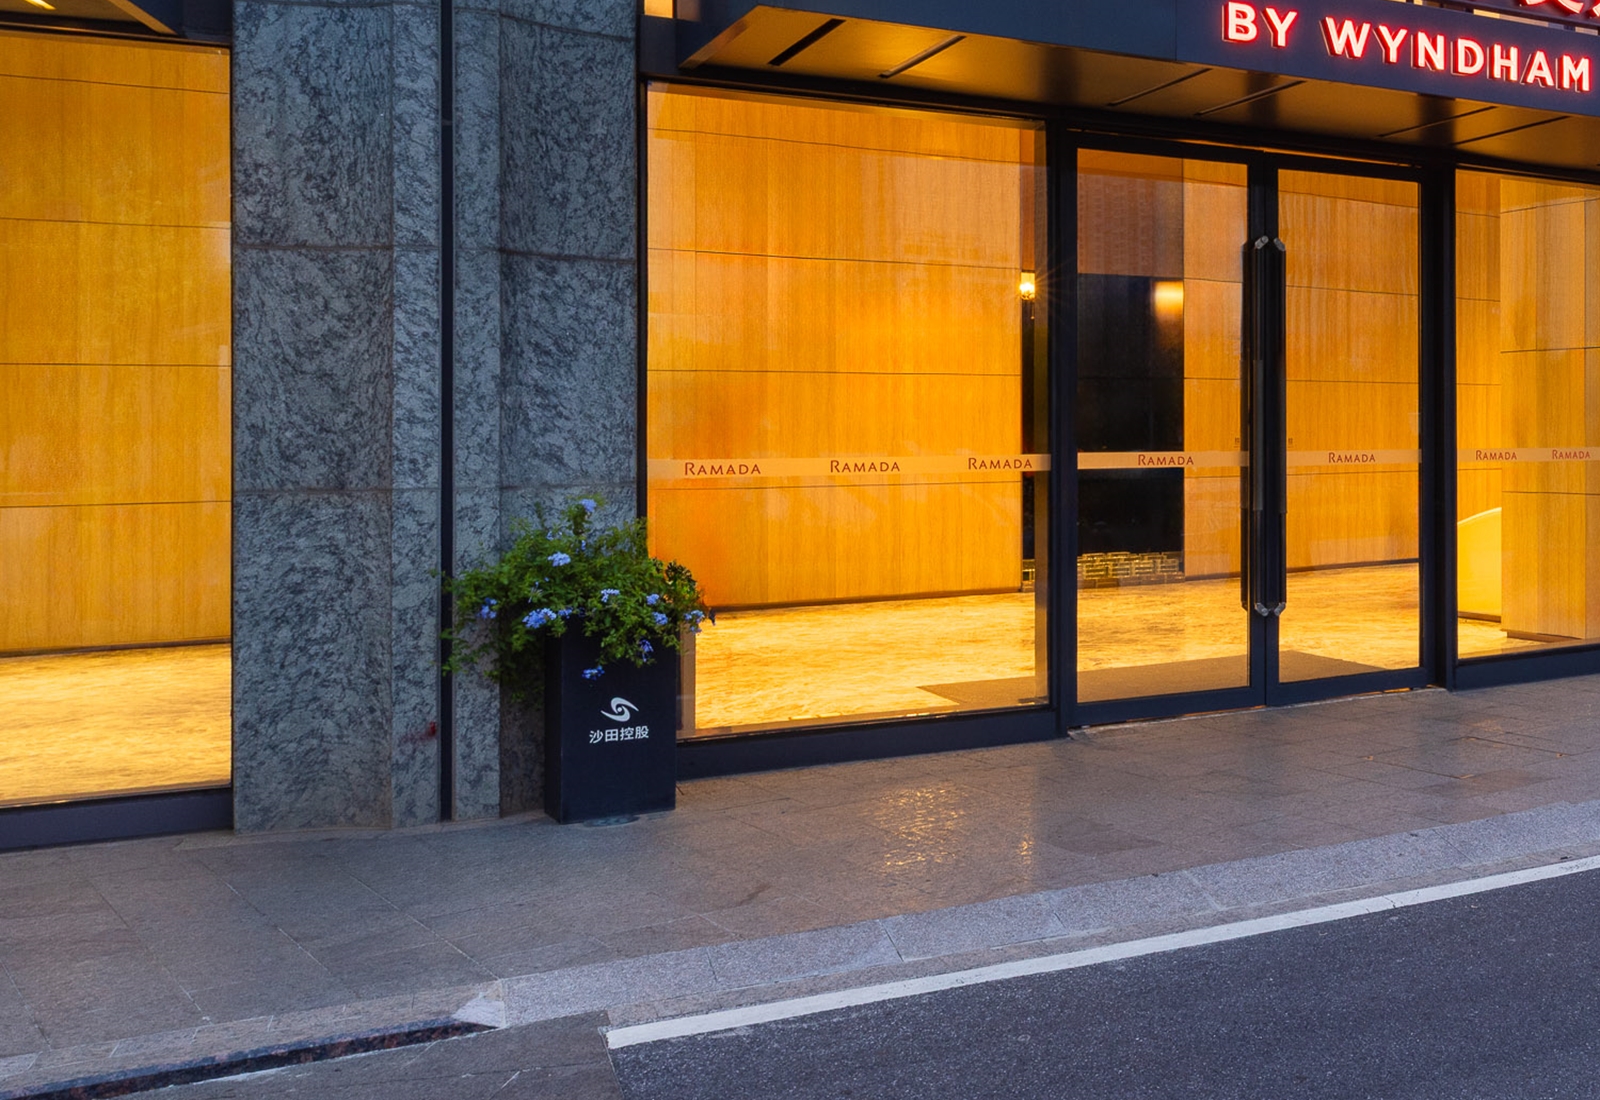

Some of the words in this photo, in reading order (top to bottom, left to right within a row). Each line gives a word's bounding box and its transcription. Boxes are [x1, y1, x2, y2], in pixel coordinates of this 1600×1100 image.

[1223, 0, 1298, 48] BY
[1320, 15, 1592, 92] WYNDHAM
[1137, 453, 1195, 467] RAMADA
[1328, 451, 1376, 464] RAMADA
[1475, 449, 1518, 462] RAMADA
[1551, 448, 1591, 461] RAMADA
[684, 461, 761, 477] RAMADA
[829, 459, 901, 474] RAMADA
[967, 456, 1033, 470] RAMADA
[589, 725, 649, 744] 沙田控股
